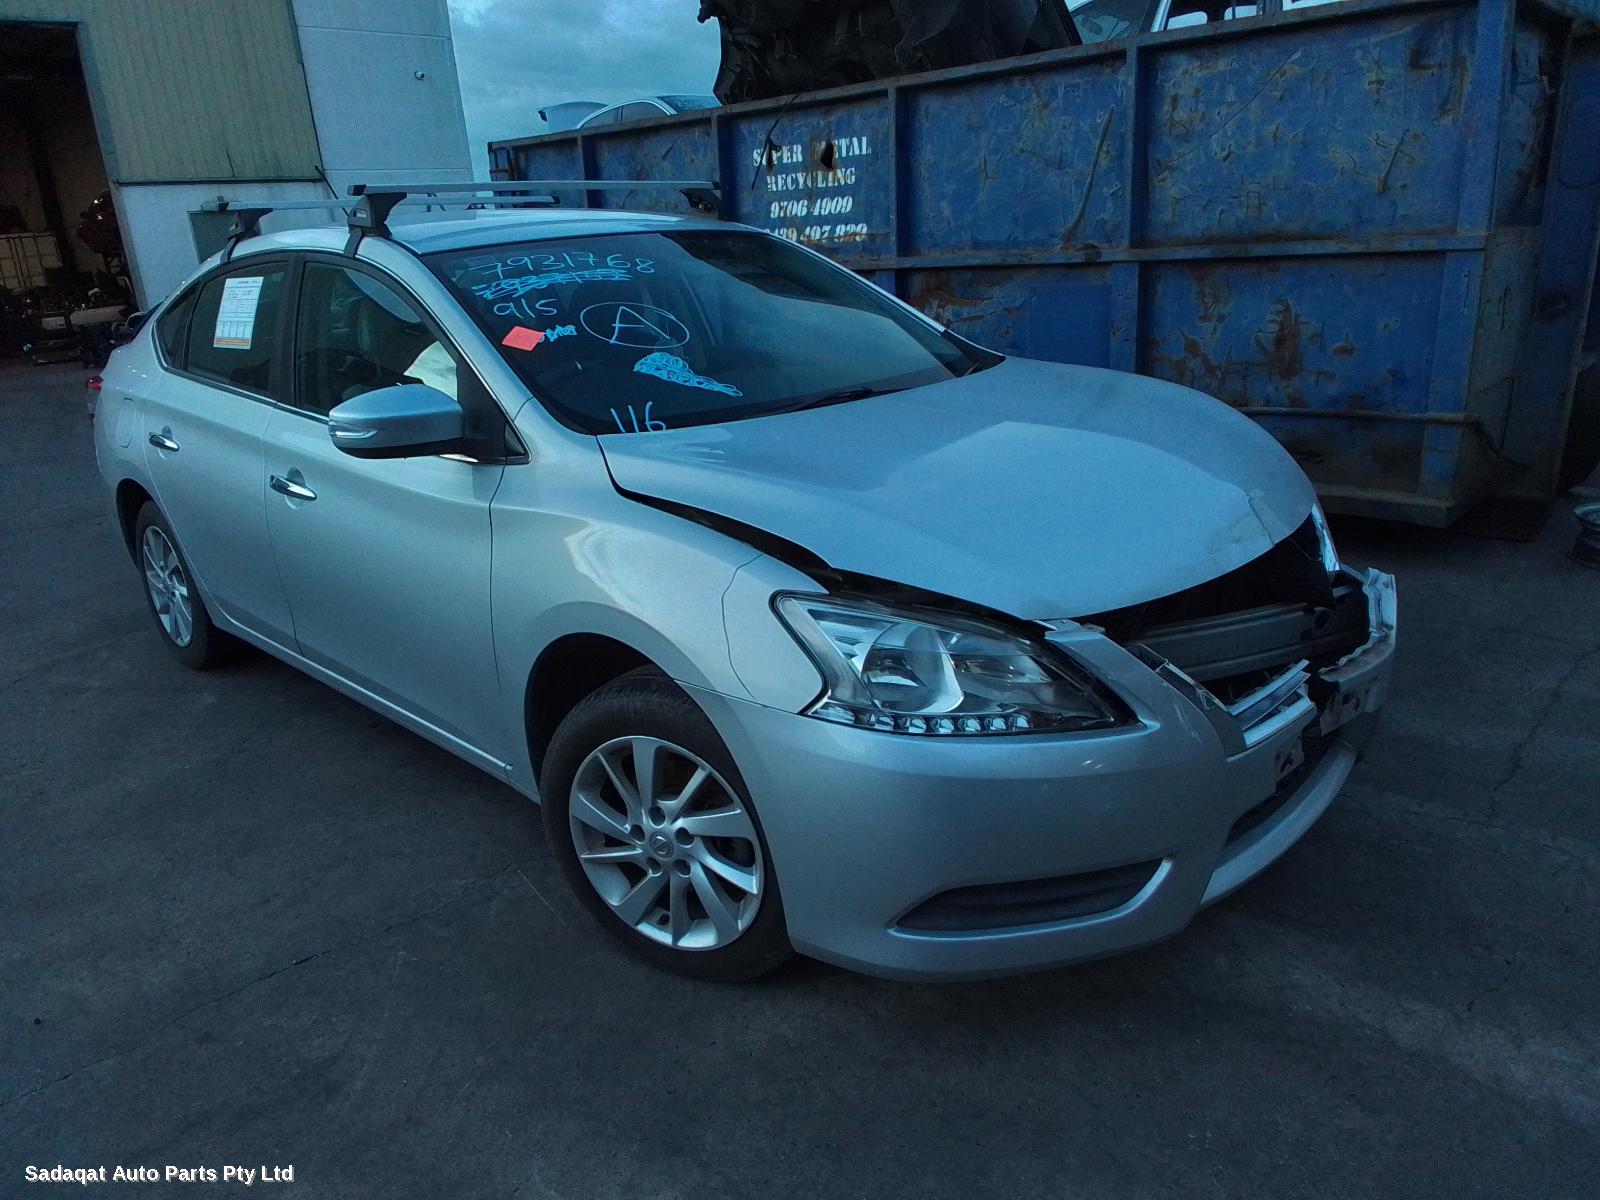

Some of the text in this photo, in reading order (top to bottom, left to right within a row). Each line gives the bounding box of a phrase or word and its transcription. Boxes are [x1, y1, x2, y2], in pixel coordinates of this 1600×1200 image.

[766, 167, 856, 192] RECYCLING
[770, 196, 853, 219] 9706 4909
[467, 252, 656, 280] 7931768
[609, 400, 667, 433] 116
